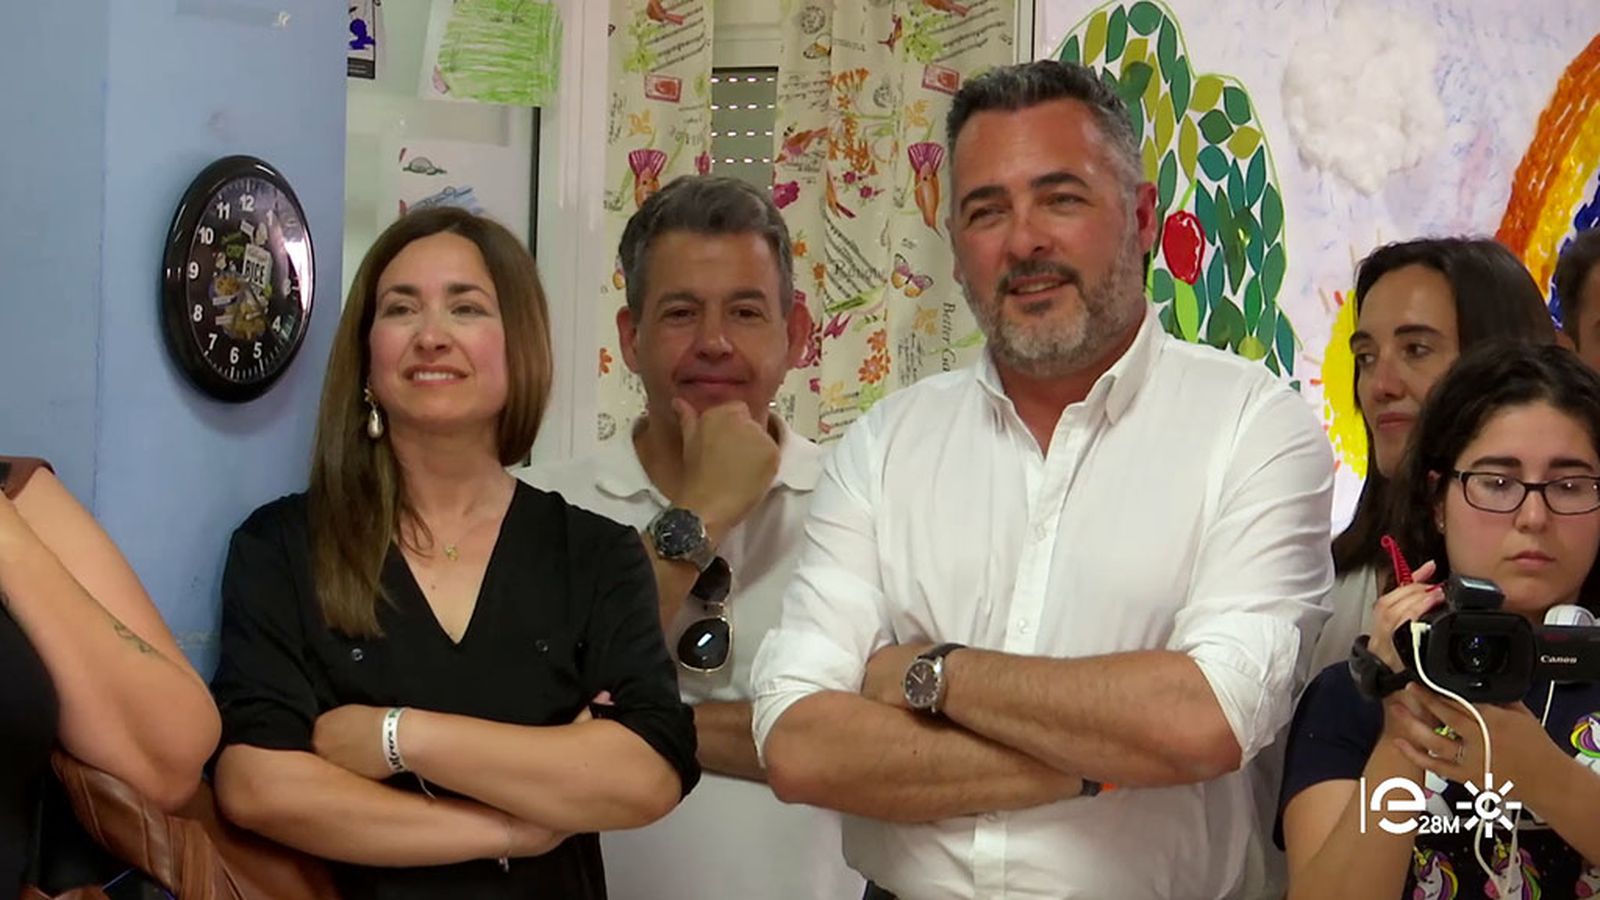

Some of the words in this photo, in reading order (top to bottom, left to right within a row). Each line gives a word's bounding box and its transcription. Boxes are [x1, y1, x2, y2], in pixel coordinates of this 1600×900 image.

[217, 202, 231, 220] 11
[239, 194, 254, 212] 12
[266, 209, 274, 226] 1
[199, 227, 214, 245] 10
[188, 261, 199, 279] 9
[193, 304, 203, 322] 8
[272, 315, 282, 332] 4
[942, 302, 956, 345] Better
[208, 333, 218, 350] 7
[253, 342, 262, 359] 5
[230, 346, 239, 364] 6
[1540, 654, 1577, 664] Canon
